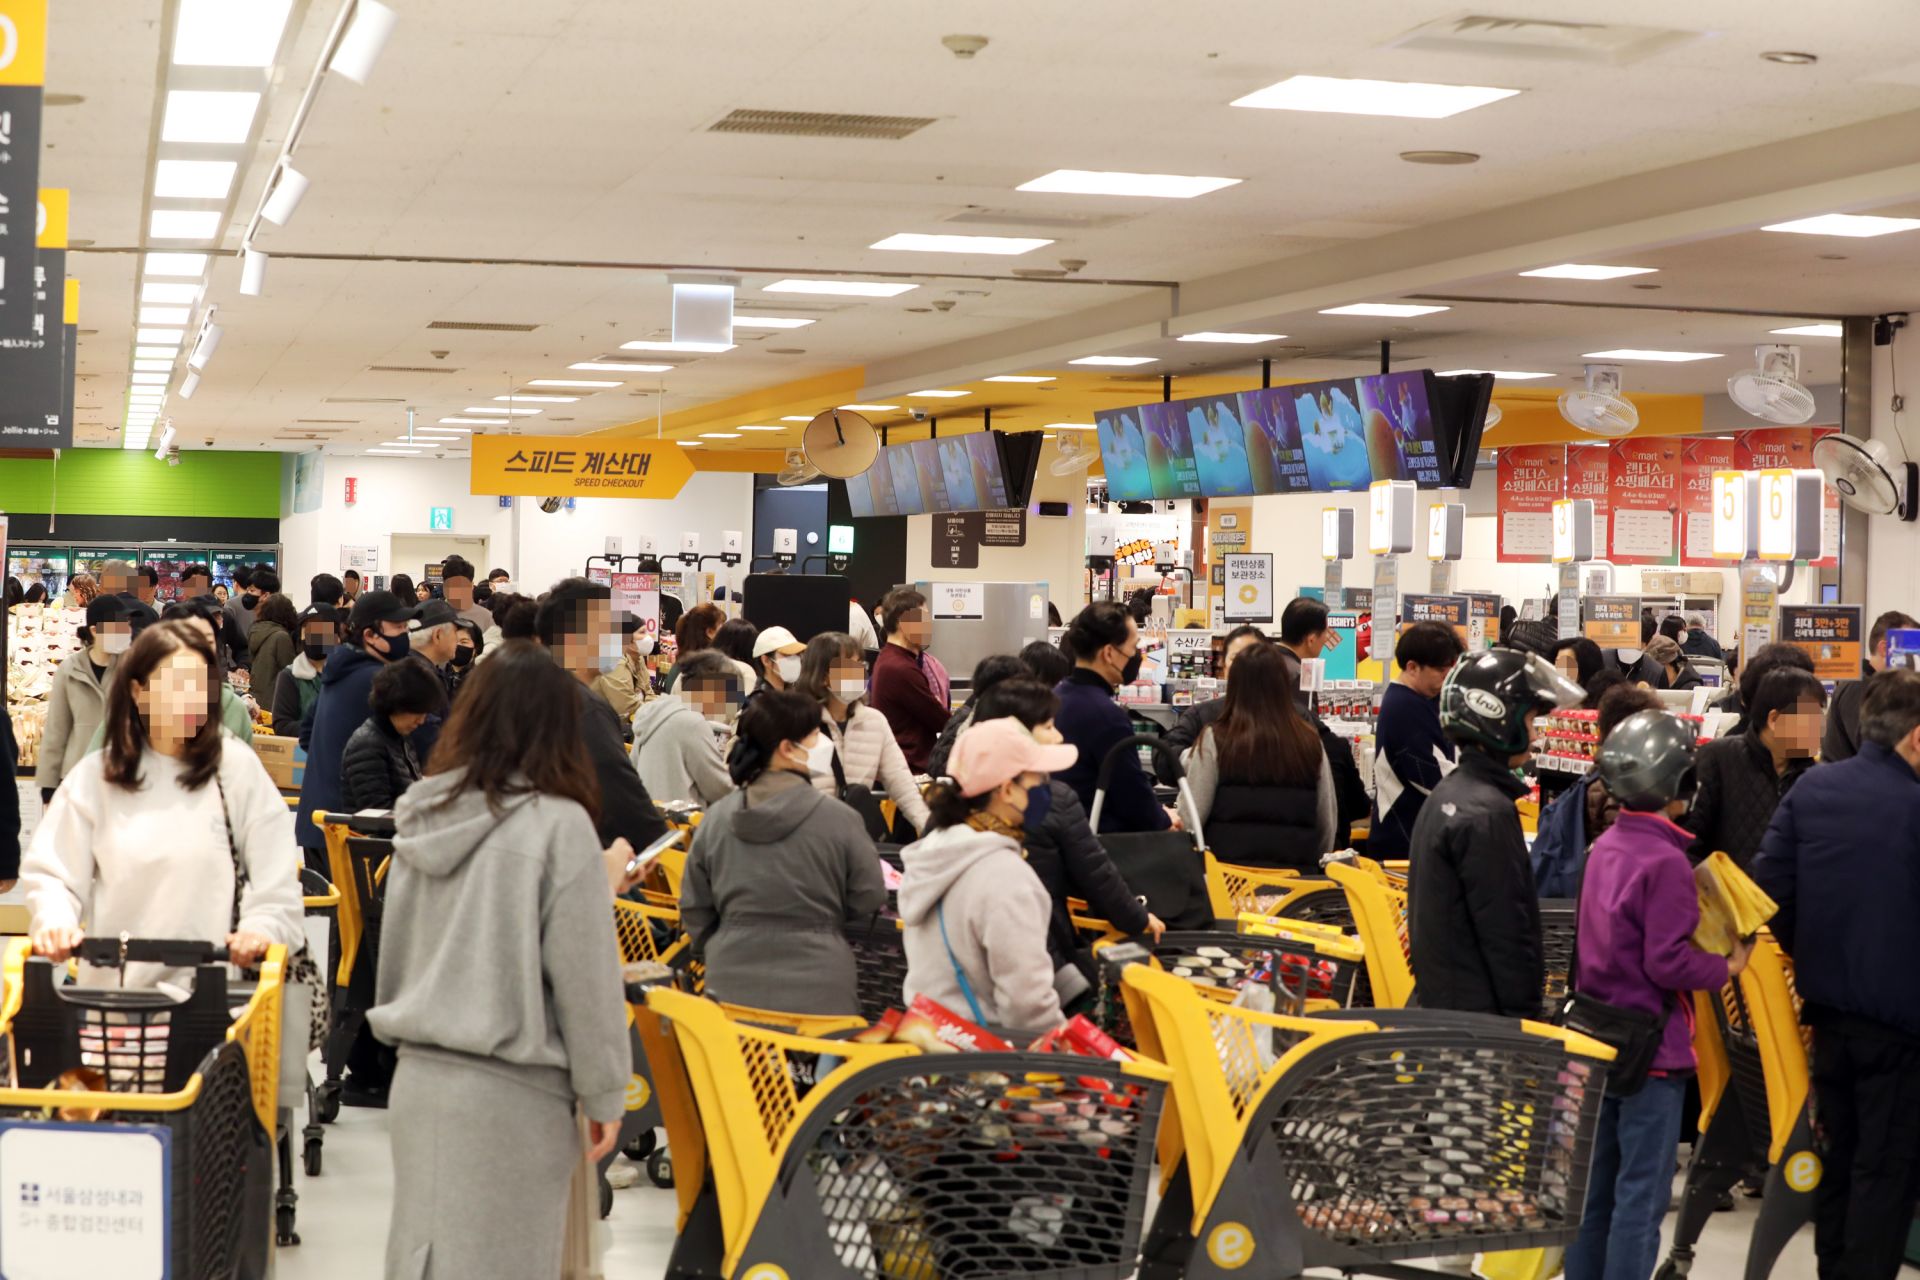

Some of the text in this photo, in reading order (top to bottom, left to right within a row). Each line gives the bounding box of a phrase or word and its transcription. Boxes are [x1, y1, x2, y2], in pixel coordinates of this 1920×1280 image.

[1632, 452, 1658, 461] emart
[504, 450, 651, 476] 스피드 계산대
[1626, 461, 1664, 475] 랜더스
[1513, 467, 1550, 480] 랜더스
[574, 477, 645, 489] SPEED CHECKOUT
[1502, 479, 1559, 493] 쇼핑페스타
[1614, 473, 1675, 490] 쇼핑페스타
[1770, 475, 1783, 520] 6
[1558, 503, 1567, 536] 3
[646, 541, 652, 549] 2
[688, 539, 693, 548] 3
[729, 539, 735, 548] 4
[784, 537, 790, 546] 5
[1101, 536, 1108, 545] 7
[1115, 539, 1151, 561] SONG
[1231, 559, 1266, 569] 리턴상품
[1231, 570, 1267, 580] 보관장소
[1413, 604, 1429, 613] 최대
[1795, 617, 1850, 629] 최대 3만+3만
[1794, 628, 1814, 638] 신세계
[1815, 629, 1835, 638] 포인트
[1470, 693, 1500, 713] Arai
[46, 1186, 143, 1207] 서울삼성내과
[48, 1213, 143, 1234] 종합검진센터
